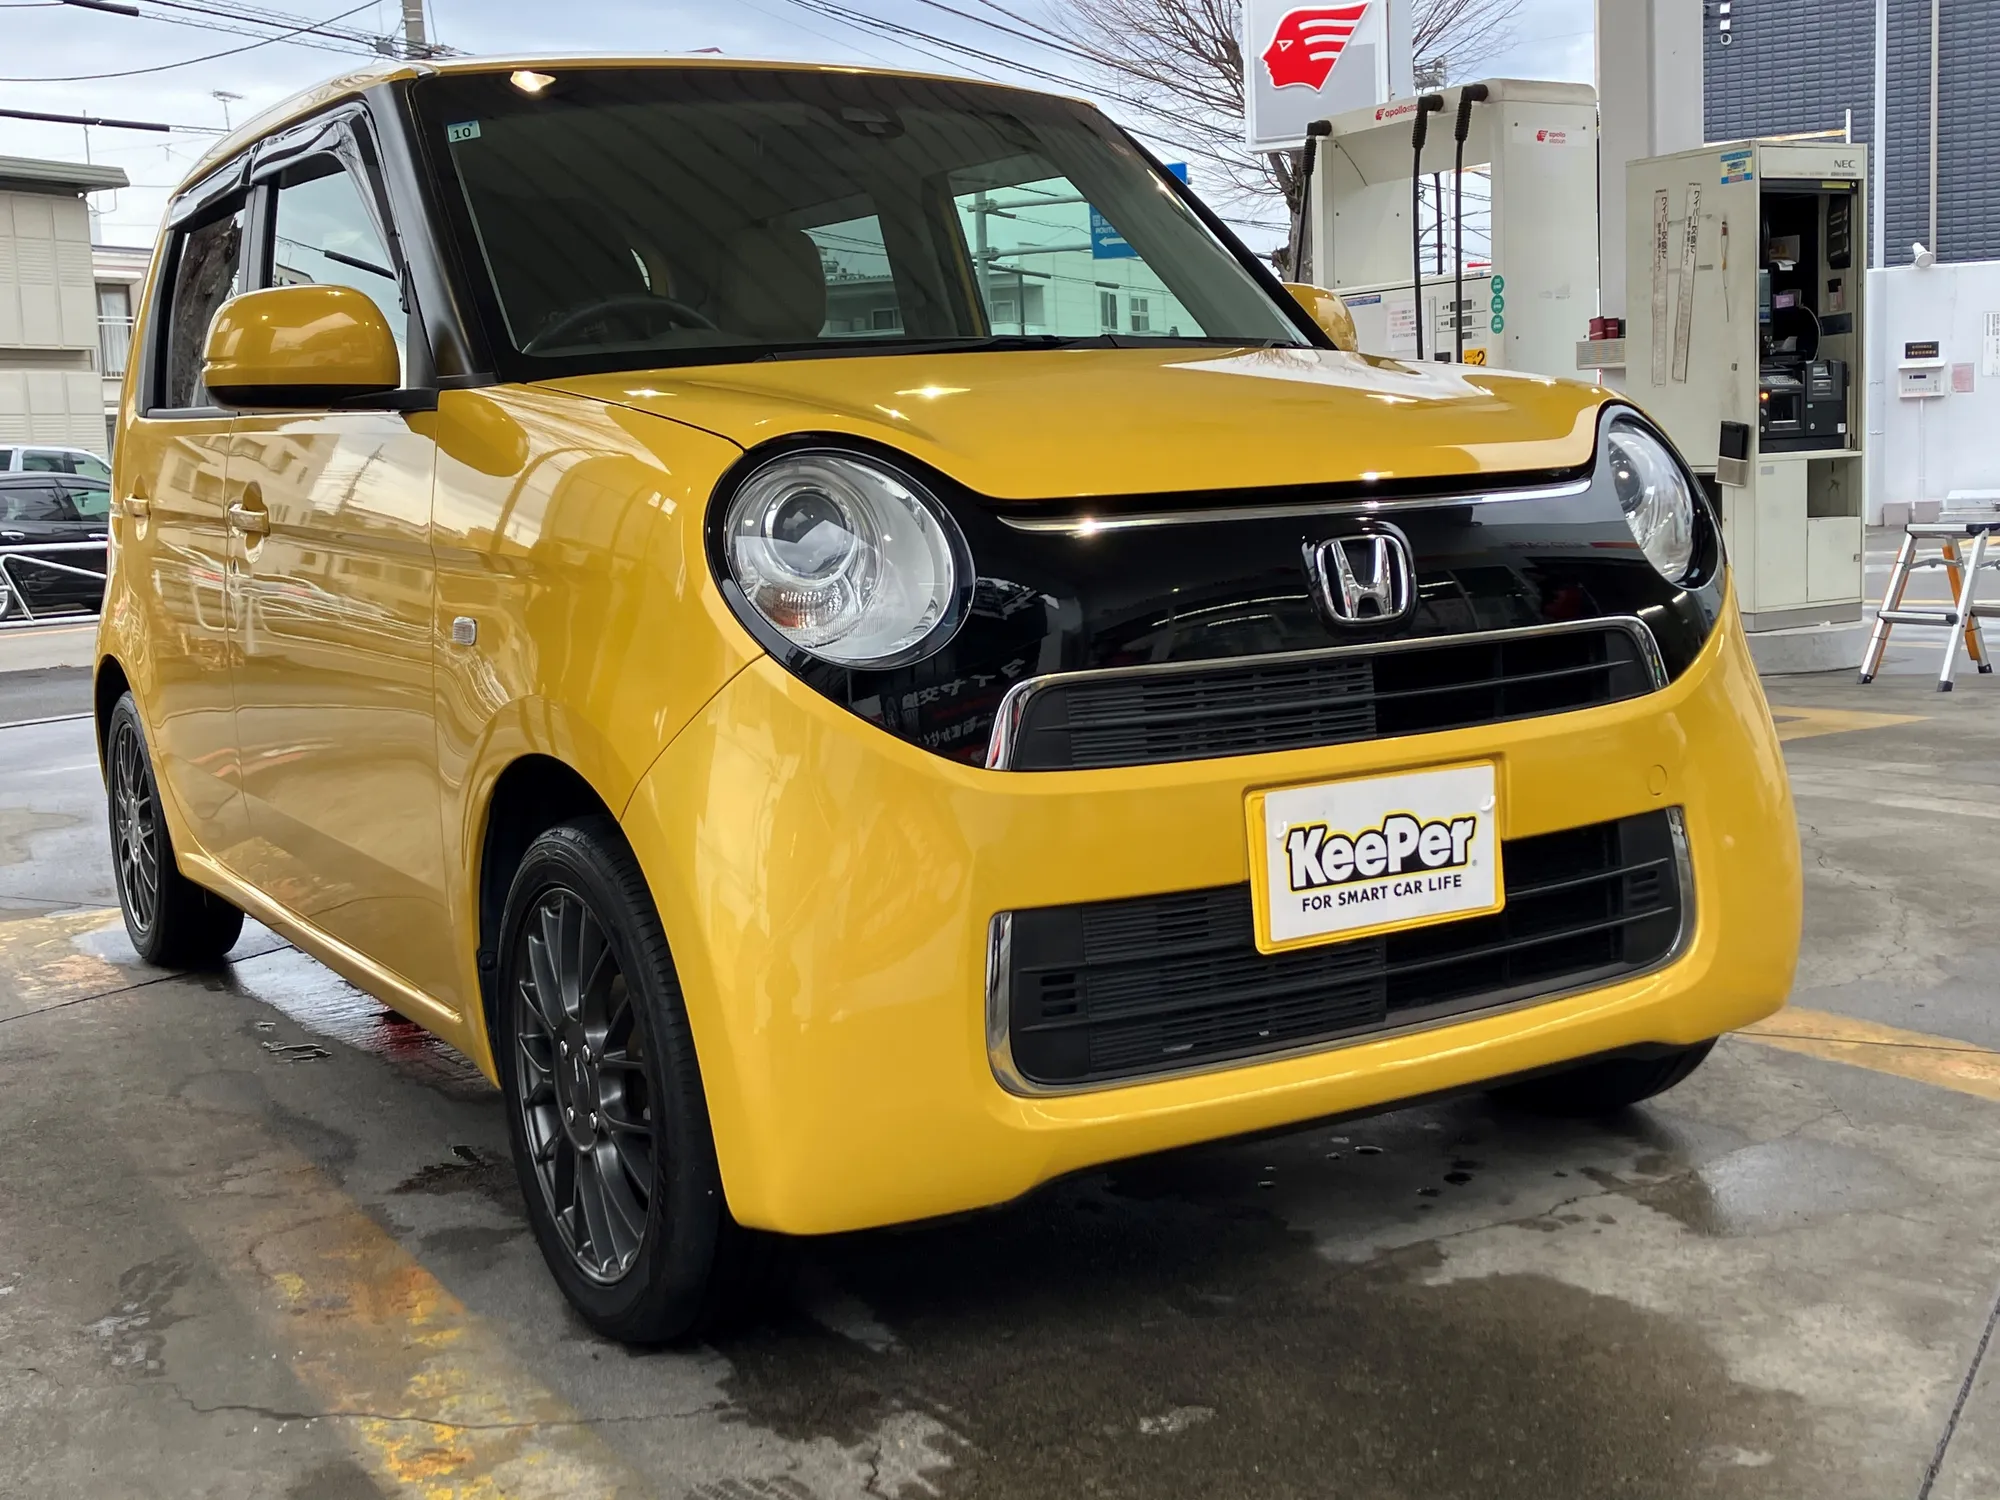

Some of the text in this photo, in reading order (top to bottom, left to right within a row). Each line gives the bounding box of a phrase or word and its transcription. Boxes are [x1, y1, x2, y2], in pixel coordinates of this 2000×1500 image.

[1385, 104, 1419, 118] apollosta
[454, 127, 471, 140] 10
[1834, 159, 1856, 169] NEC
[1690, 190, 1700, 254] ワイパー交換で
[1285, 813, 1476, 891] KeePer
[1301, 873, 1463, 913] FOR SMART CAR LIFE
